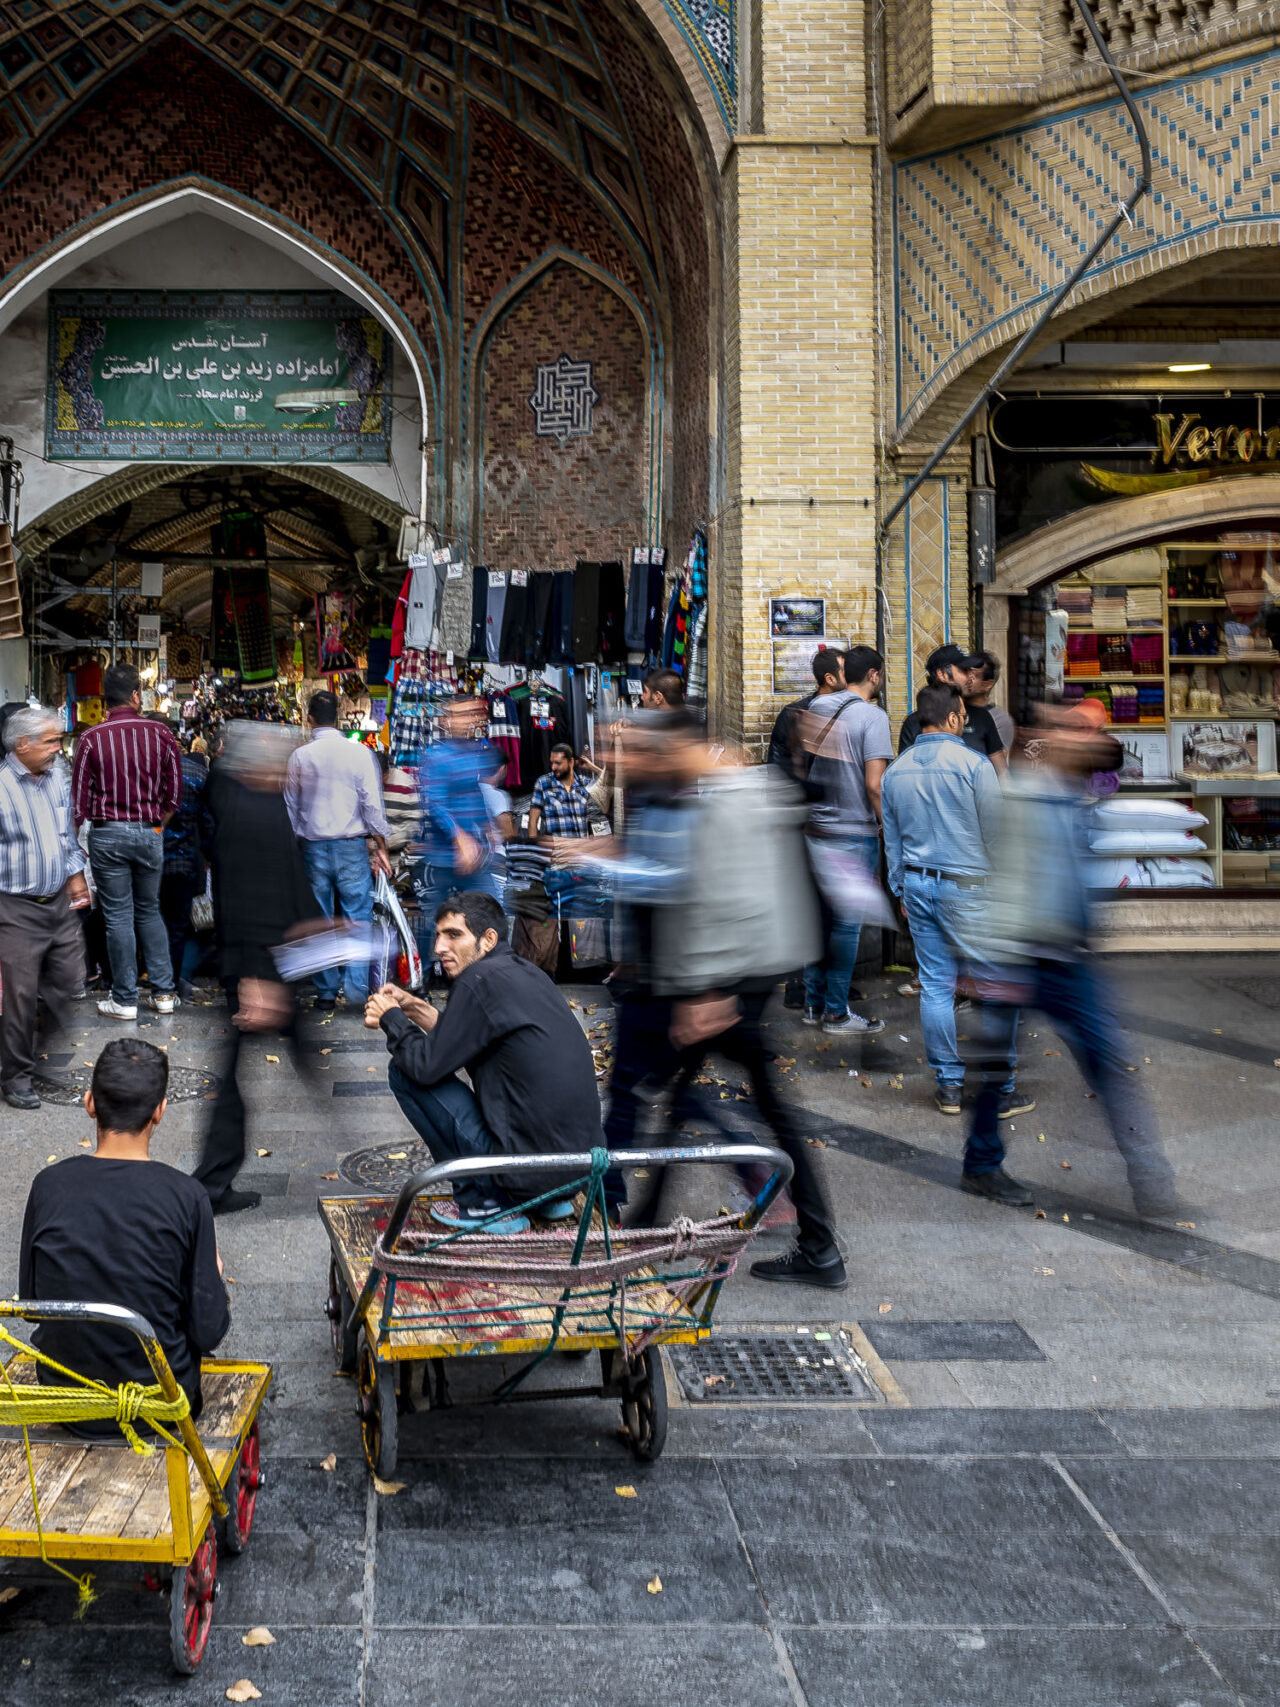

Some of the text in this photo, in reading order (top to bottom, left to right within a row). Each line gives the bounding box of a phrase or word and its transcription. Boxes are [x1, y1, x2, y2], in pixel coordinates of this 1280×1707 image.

[171, 332, 268, 351] آستان مقدس
[100, 356, 340, 382] امامزاده زید بن علی بن الحسین
[195, 387, 264, 402] فرزند امام سجاد
